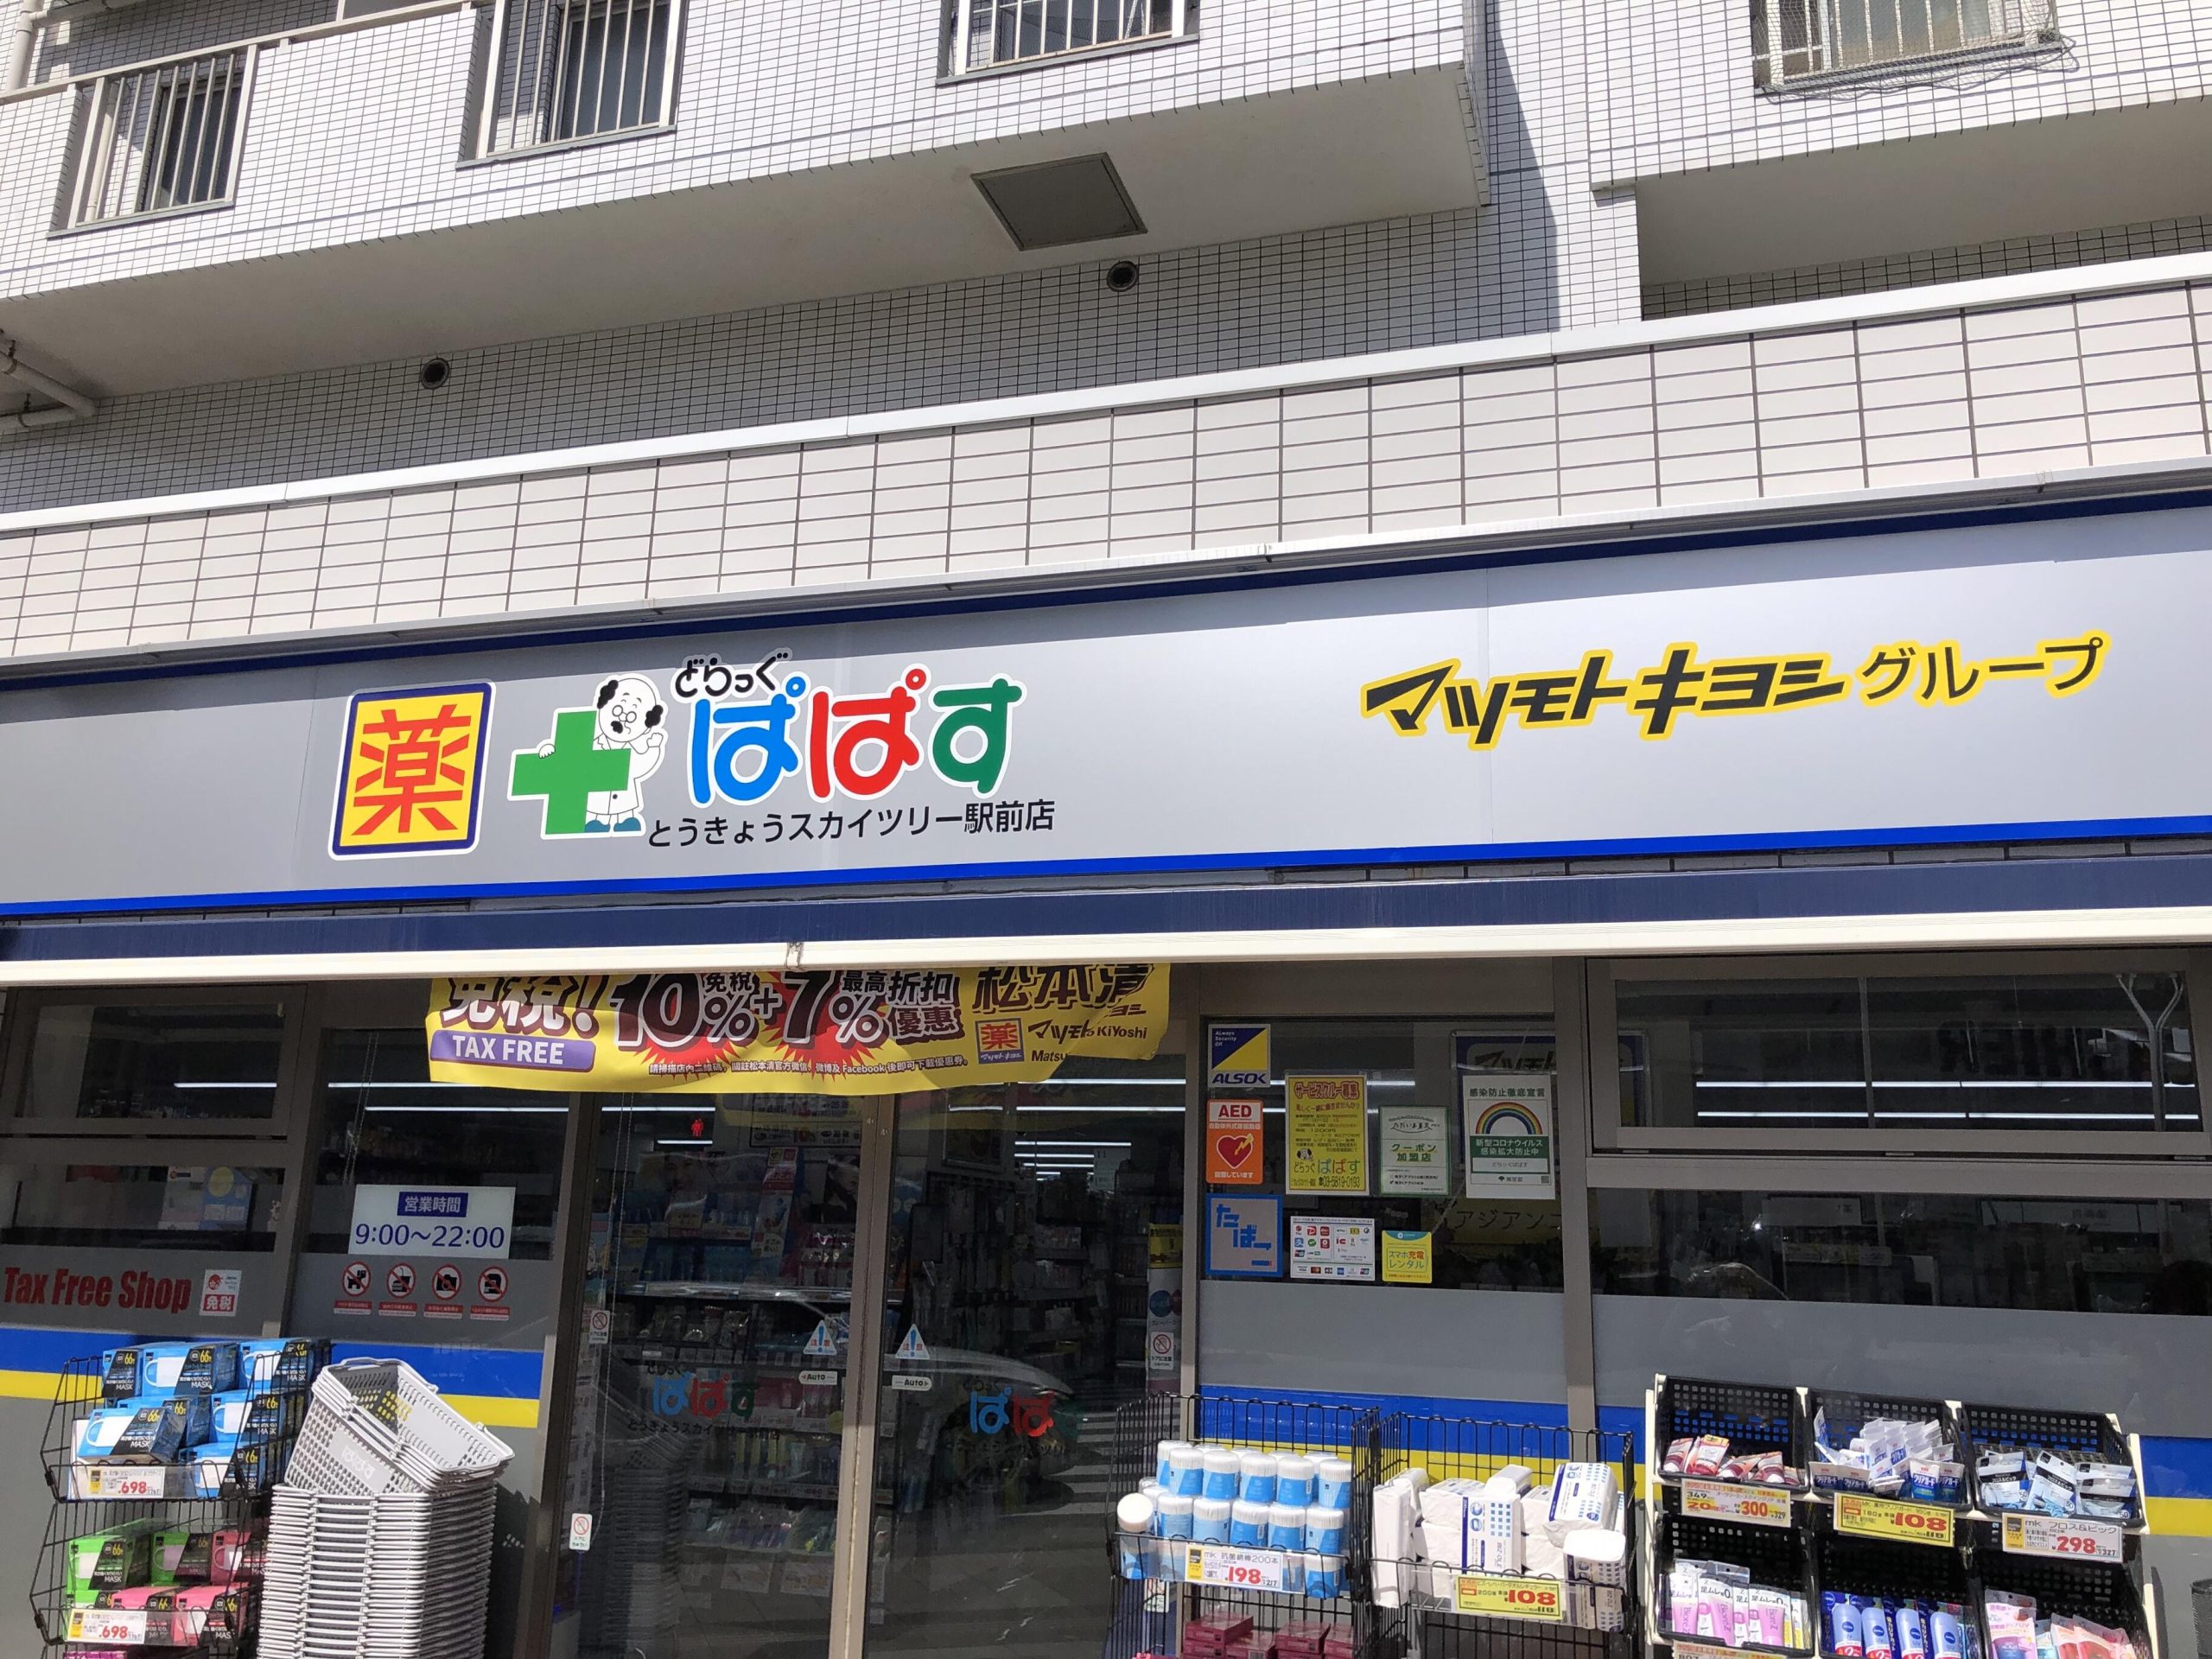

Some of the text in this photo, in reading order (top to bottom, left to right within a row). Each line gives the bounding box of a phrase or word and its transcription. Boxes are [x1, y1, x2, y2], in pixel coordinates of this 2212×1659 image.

[676, 652, 788, 694] どらっぐ
[693, 669, 1023, 805] ぱぱす
[354, 703, 473, 836] 薬
[647, 798, 1056, 849] とうきょうスカイツリー駅前店
[842, 970, 887, 994] 最高
[888, 973, 957, 1005] 折扣
[980, 1022, 1019, 1051] 薬
[452, 1035, 564, 1065] TAX FREE
[842, 1064, 886, 1075] Facebook
[1212, 1073, 1267, 1084] ALSOK
[1469, 1088, 1545, 1097] 感染防止徹底宣言
[1218, 1104, 1252, 1118] AED
[1391, 1143, 1437, 1153] クーポン
[1476, 1138, 1543, 1147] 新型コロナウイルス
[1396, 1153, 1432, 1162] 加盟店
[1480, 1147, 1539, 1156] 感染拡大防止中
[1317, 1159, 1361, 1175] ぱぱす
[404, 1196, 461, 1213] 営業時間
[1389, 1260, 1425, 1269] レンタル
[3, 1266, 193, 1314] Tax Free Shop
[1741, 1500, 1768, 1517] 300
[1895, 1512, 1948, 1532] 108
[2049, 1521, 2117, 1535] フロス&ピック
[2056, 1535, 2096, 1554] 298
[1229, 1566, 1262, 1585] 198
[1509, 1589, 1556, 1606] 108
